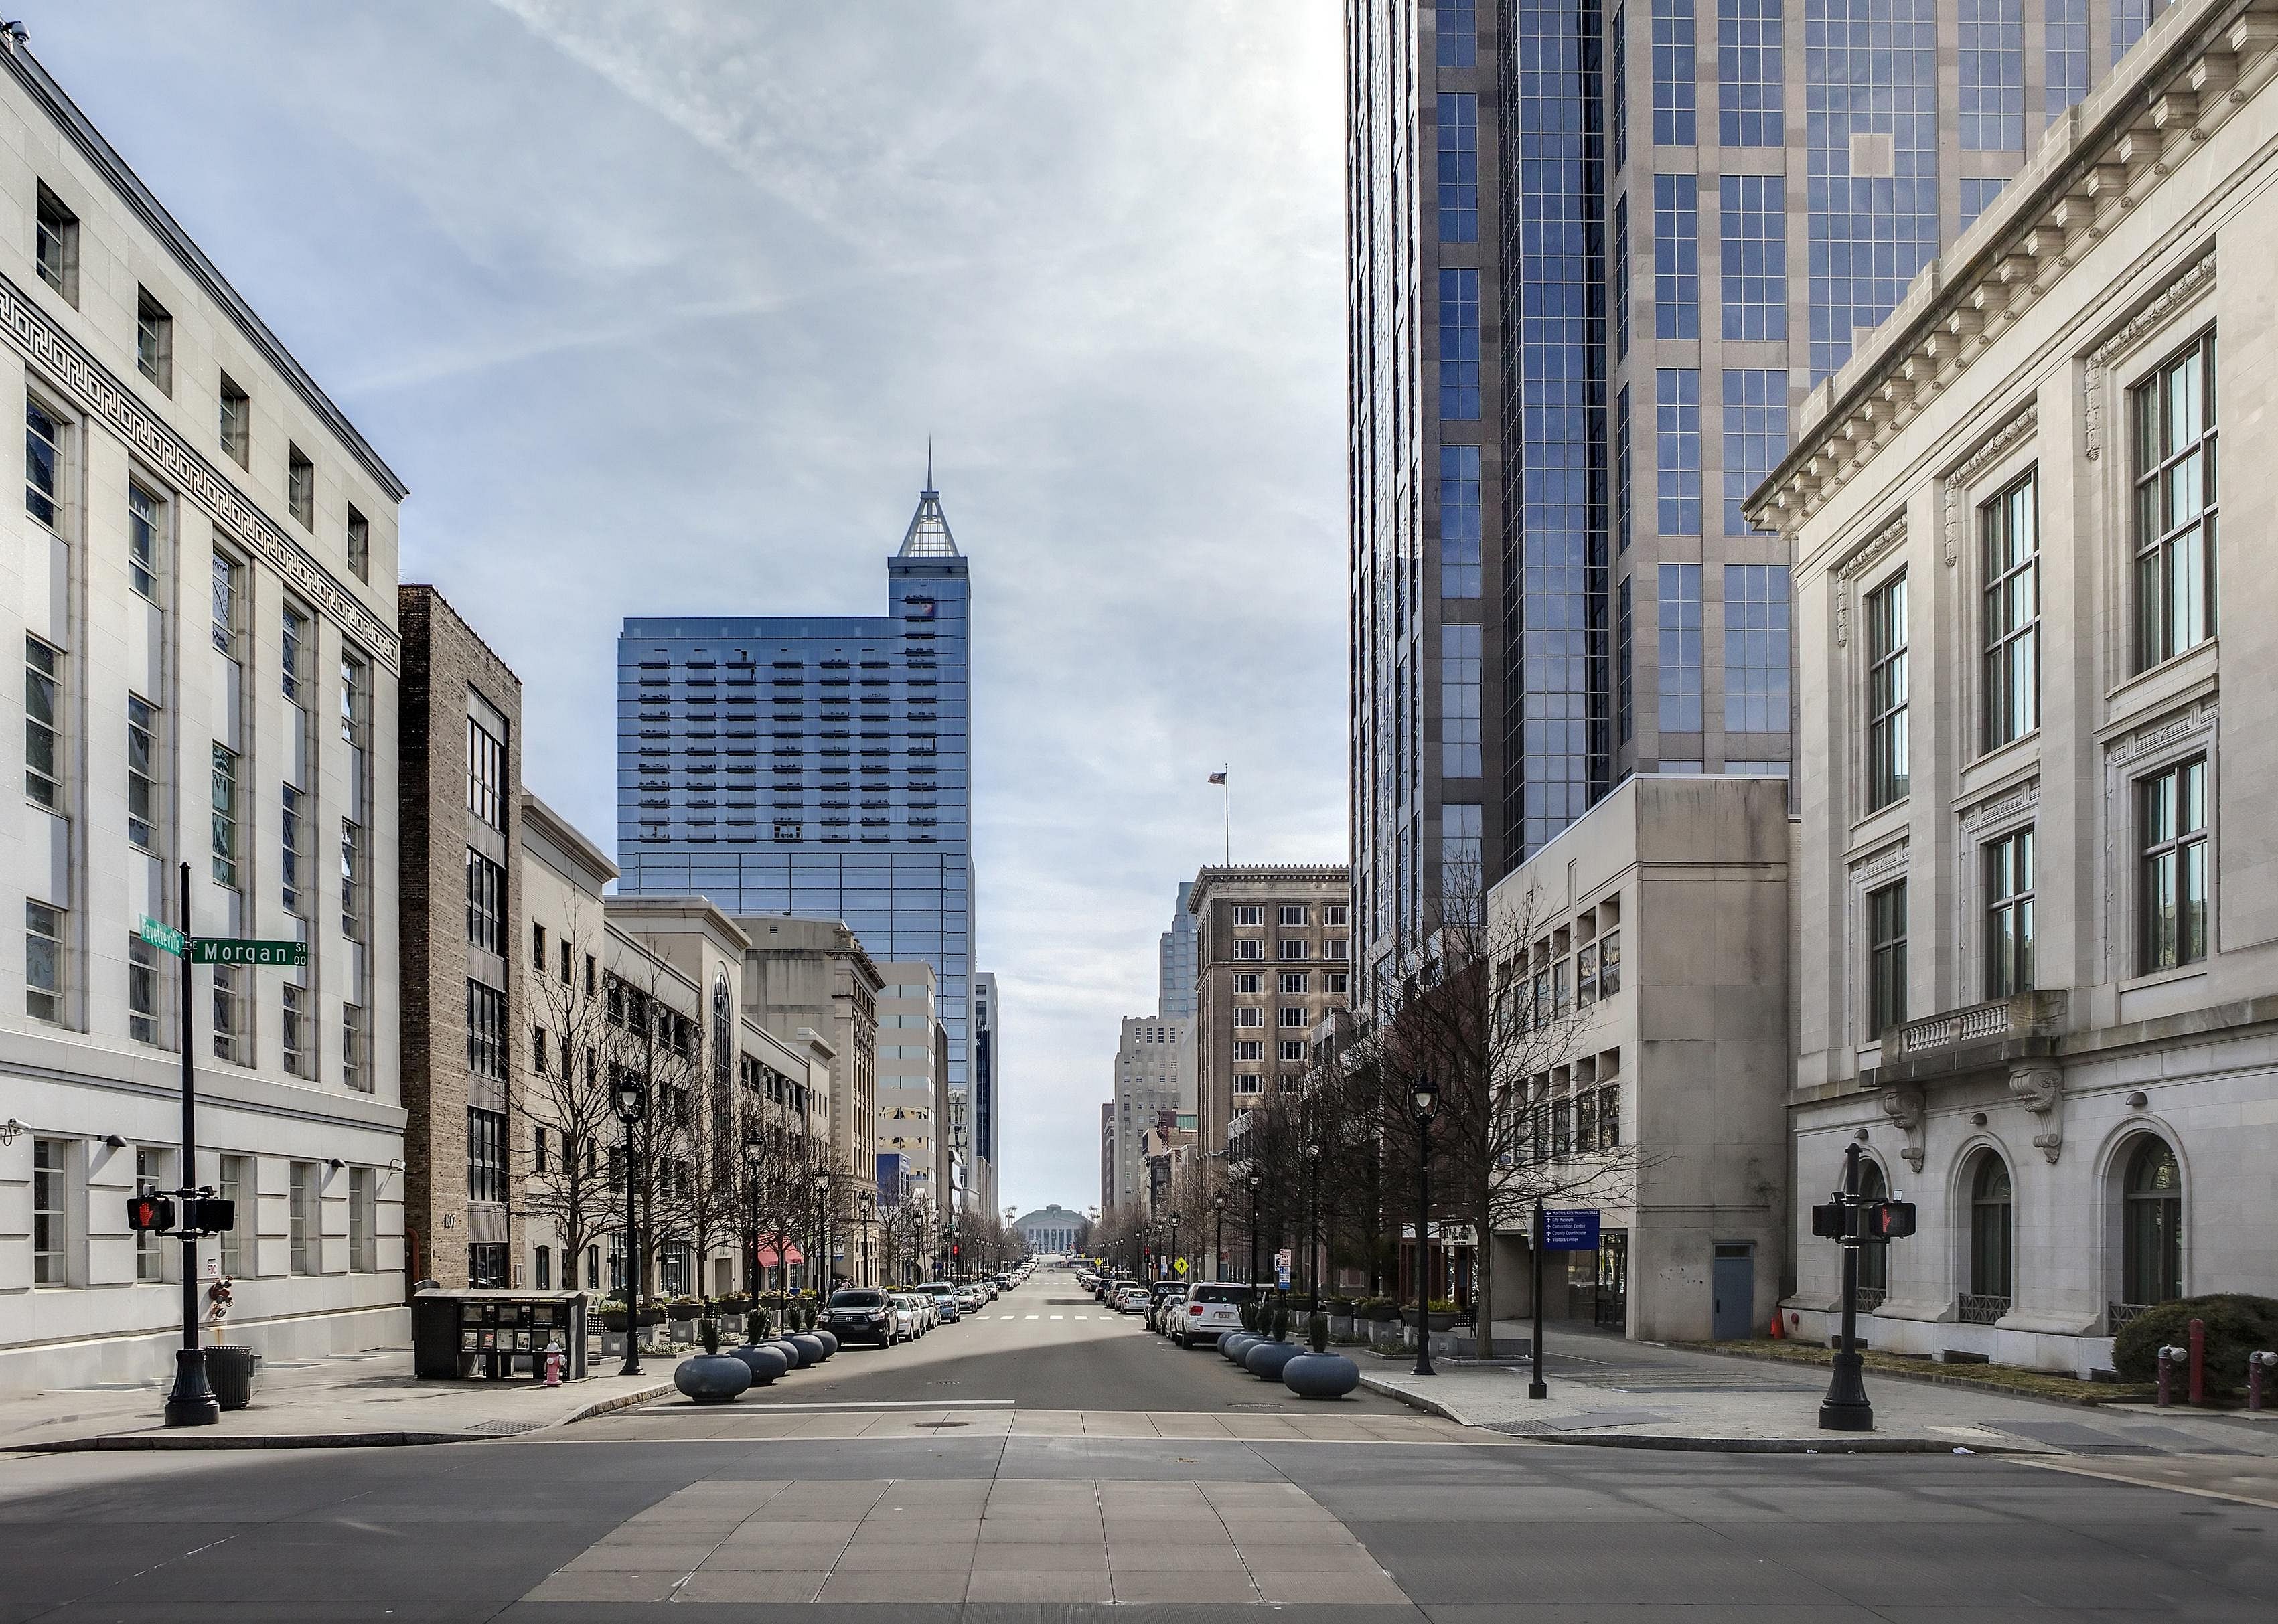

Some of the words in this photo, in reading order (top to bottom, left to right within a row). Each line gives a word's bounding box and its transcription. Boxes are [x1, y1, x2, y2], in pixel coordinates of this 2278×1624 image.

[141, 918, 179, 953] Fayetteville
[192, 941, 198, 950] E
[204, 943, 286, 963] Morgan
[295, 943, 306, 953] St
[293, 956, 306, 965] 00
